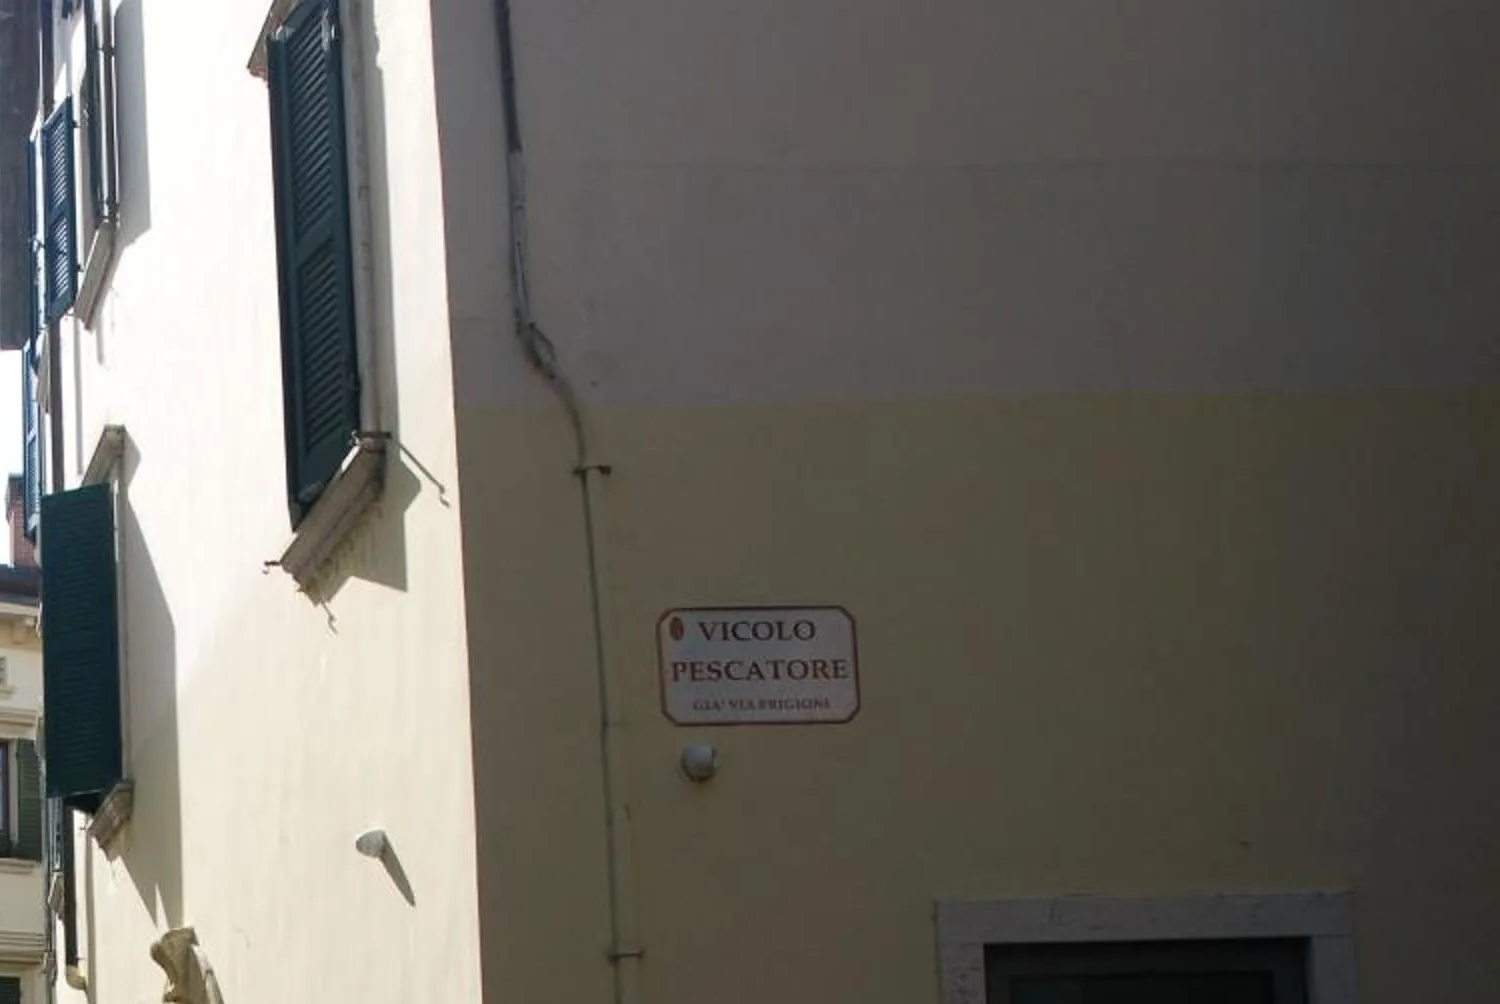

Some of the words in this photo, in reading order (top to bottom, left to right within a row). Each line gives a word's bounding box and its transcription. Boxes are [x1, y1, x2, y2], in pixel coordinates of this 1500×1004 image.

[698, 620, 816, 641] VICOLO
[671, 659, 850, 682] PESCATORE
[728, 698, 756, 711] VIA
